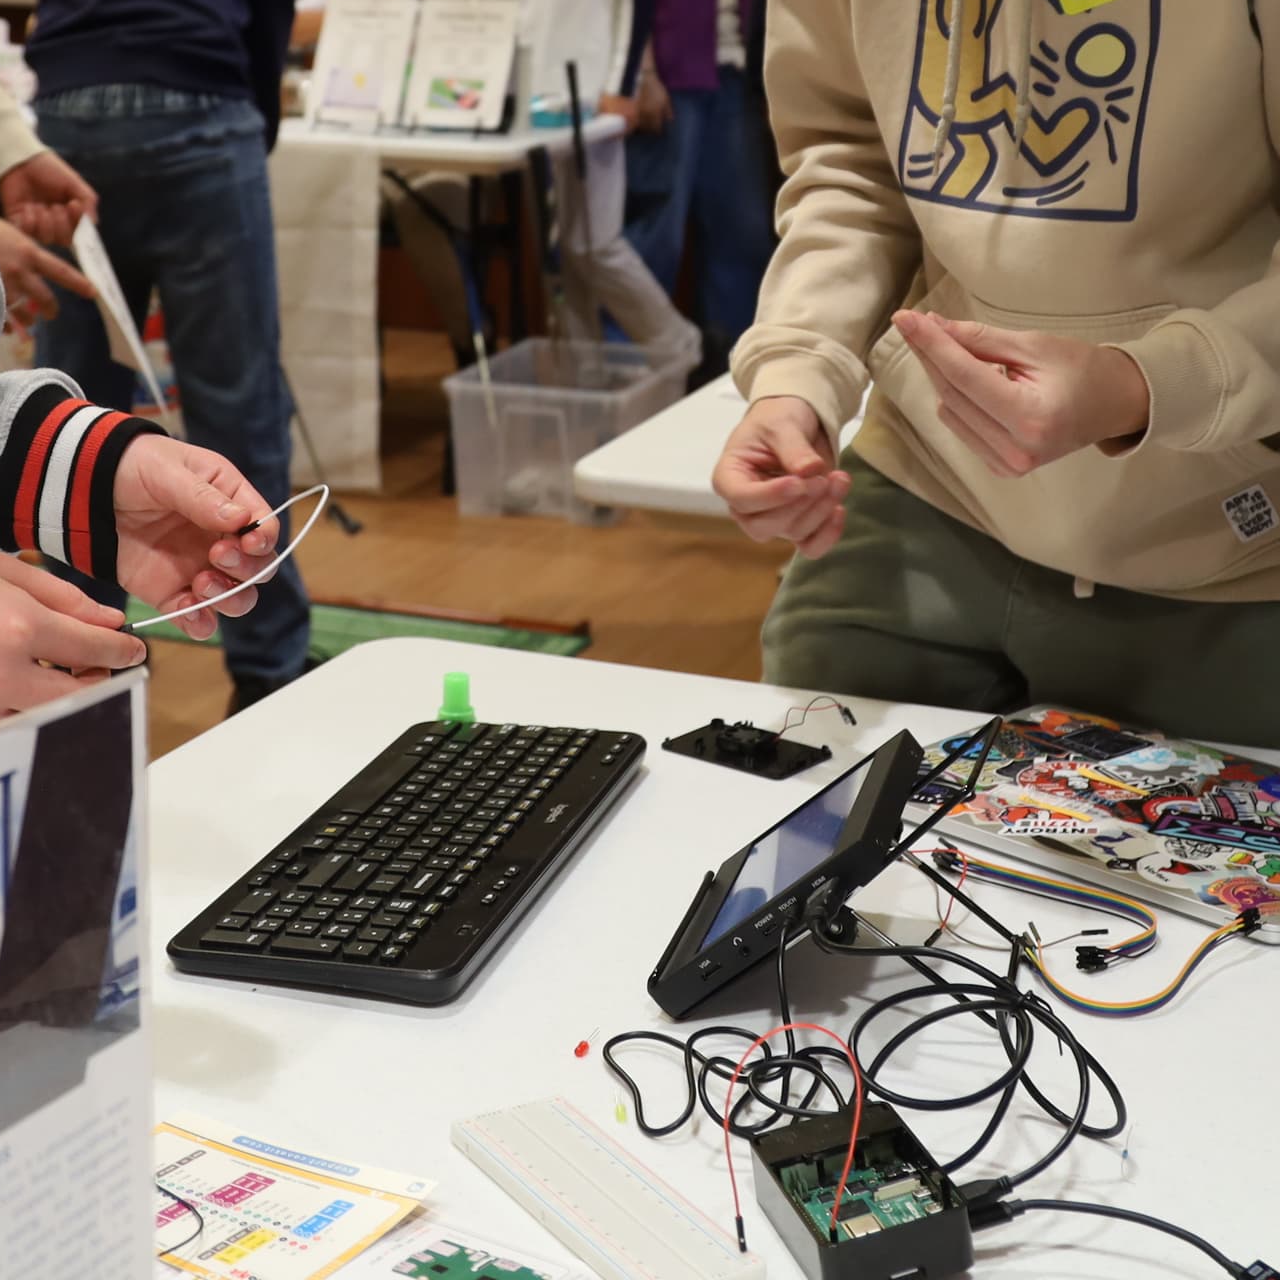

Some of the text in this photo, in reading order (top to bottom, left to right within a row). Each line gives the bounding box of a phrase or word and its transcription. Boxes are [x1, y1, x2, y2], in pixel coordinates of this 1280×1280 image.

[1226, 492, 1249, 512] ART
[778, 896, 798, 912] TOUCH
[754, 913, 774, 929] POWER
